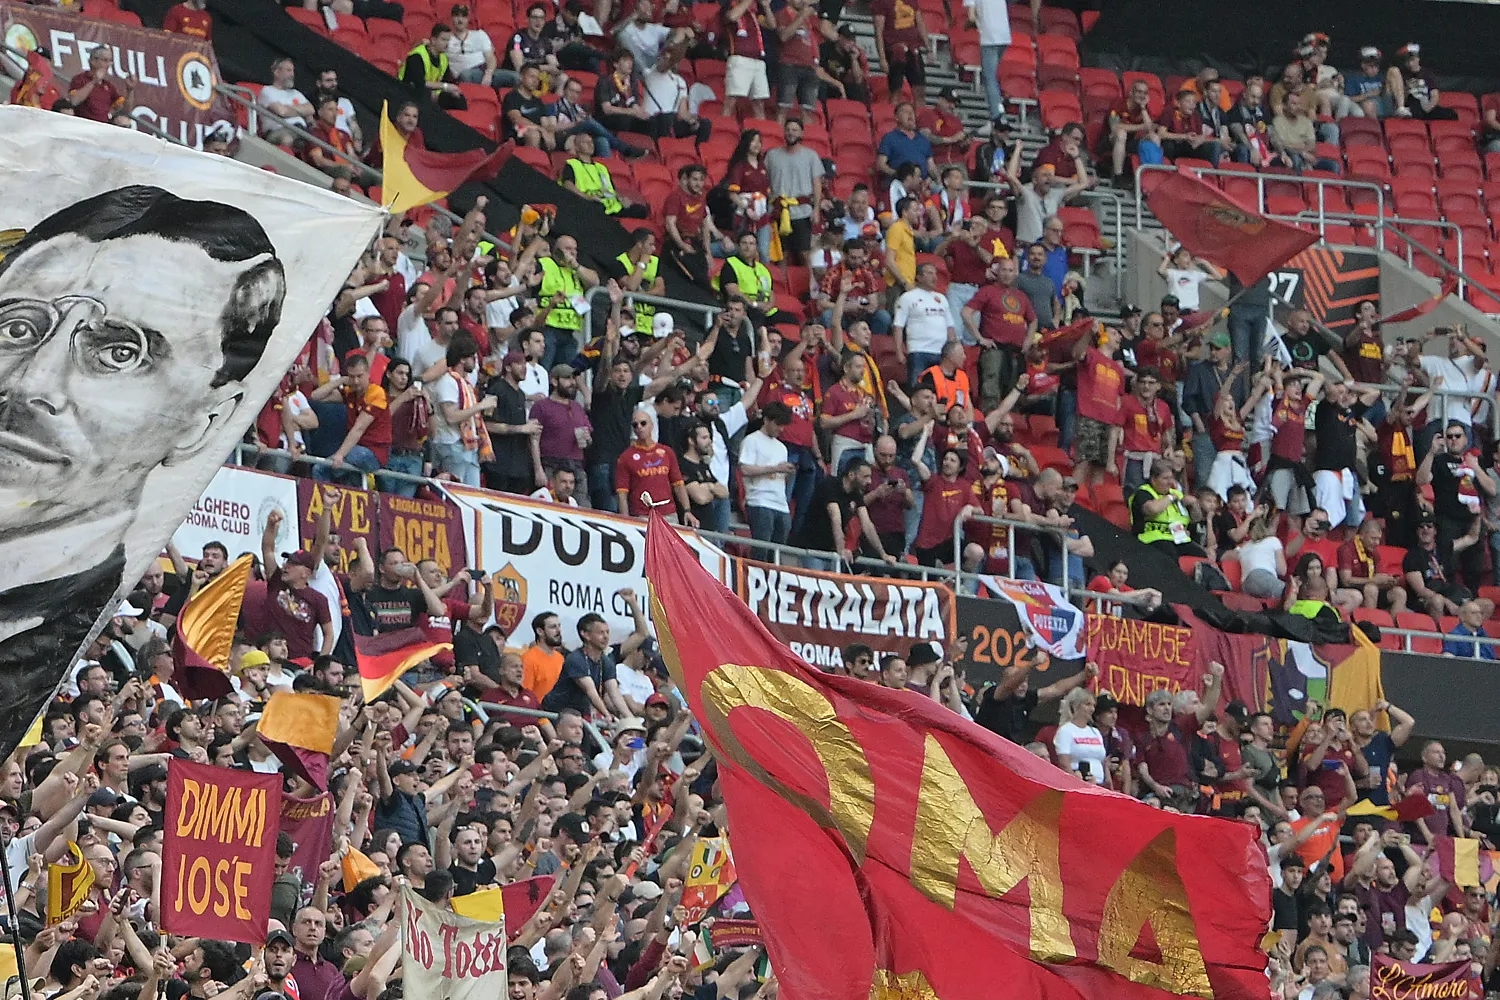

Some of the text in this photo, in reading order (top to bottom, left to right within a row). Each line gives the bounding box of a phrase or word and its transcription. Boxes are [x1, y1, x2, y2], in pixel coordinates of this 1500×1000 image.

[637, 464, 669, 477] WIND
[221, 517, 251, 536] CLUB
[306, 483, 370, 534] AVE
[550, 578, 605, 613] ROMA
[747, 565, 946, 640] PIETRALATA
[1033, 612, 1069, 634] POTENZA
[789, 641, 844, 671] ROMA
[176, 778, 267, 848] DIMMI
[680, 640, 1214, 1000] OMA
[405, 898, 434, 970] No
